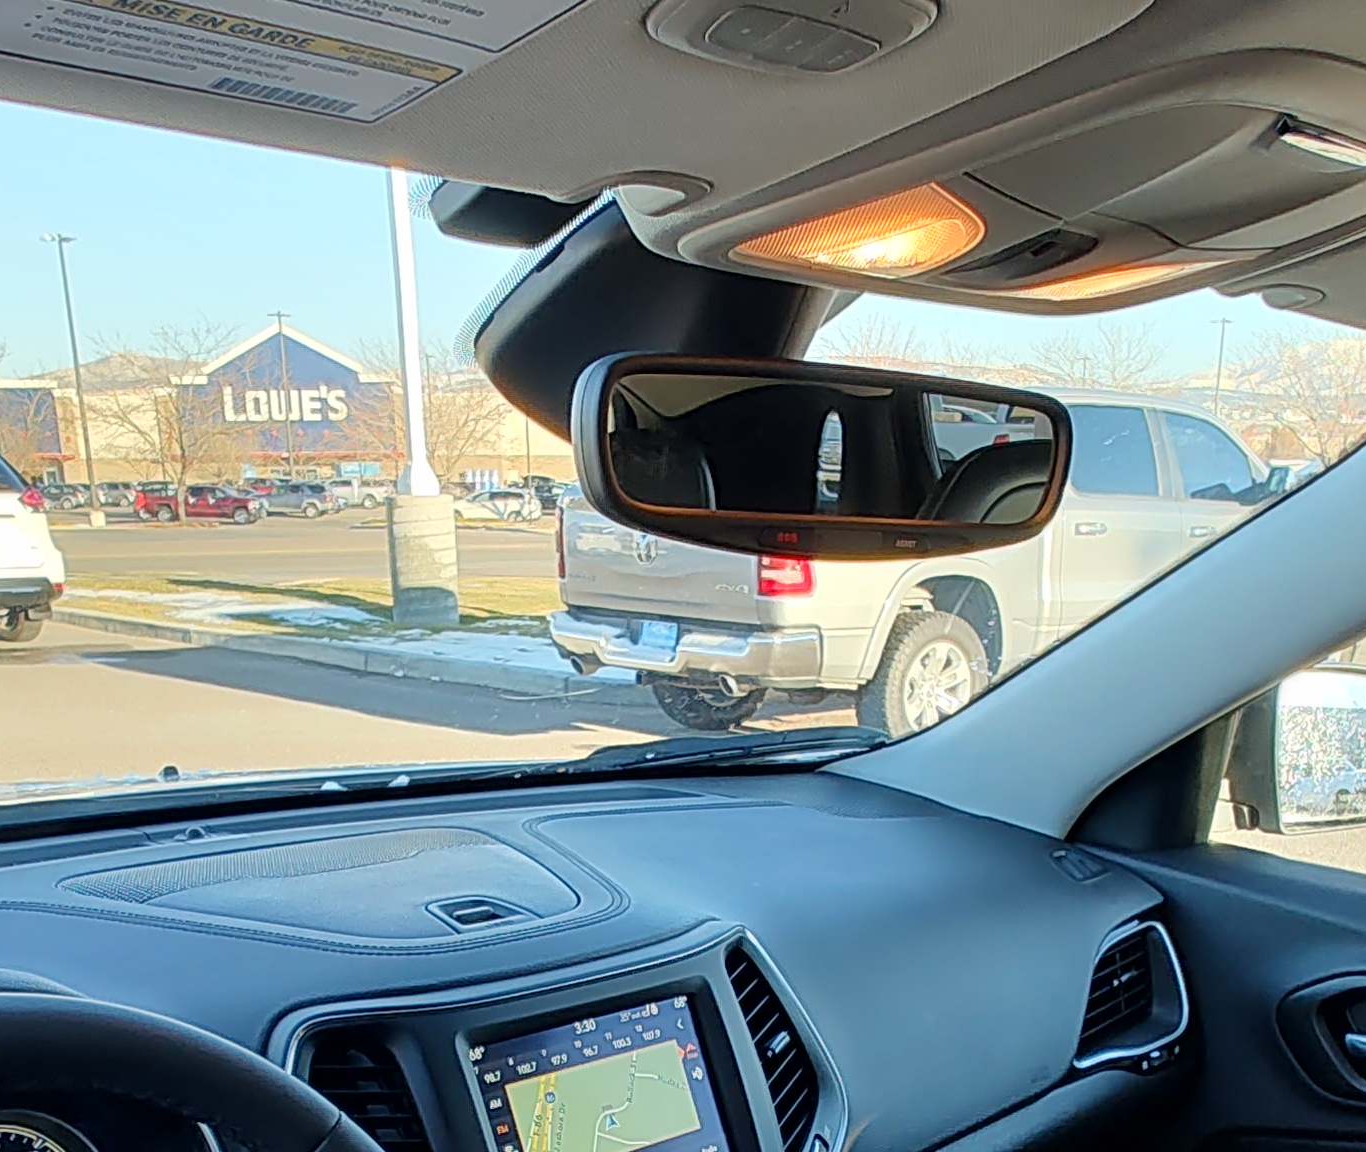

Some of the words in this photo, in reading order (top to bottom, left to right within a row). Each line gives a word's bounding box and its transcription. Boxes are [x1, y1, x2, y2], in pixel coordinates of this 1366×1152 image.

[112, 0, 183, 19] MISE
[186, 11, 227, 30] EN
[228, 22, 317, 50] GARDE
[222, 385, 349, 422] LOWE'S
[574, 1017, 597, 1035] 3:30
[550, 1053, 568, 1066] 97.9
[582, 1044, 599, 1057] 96.7
